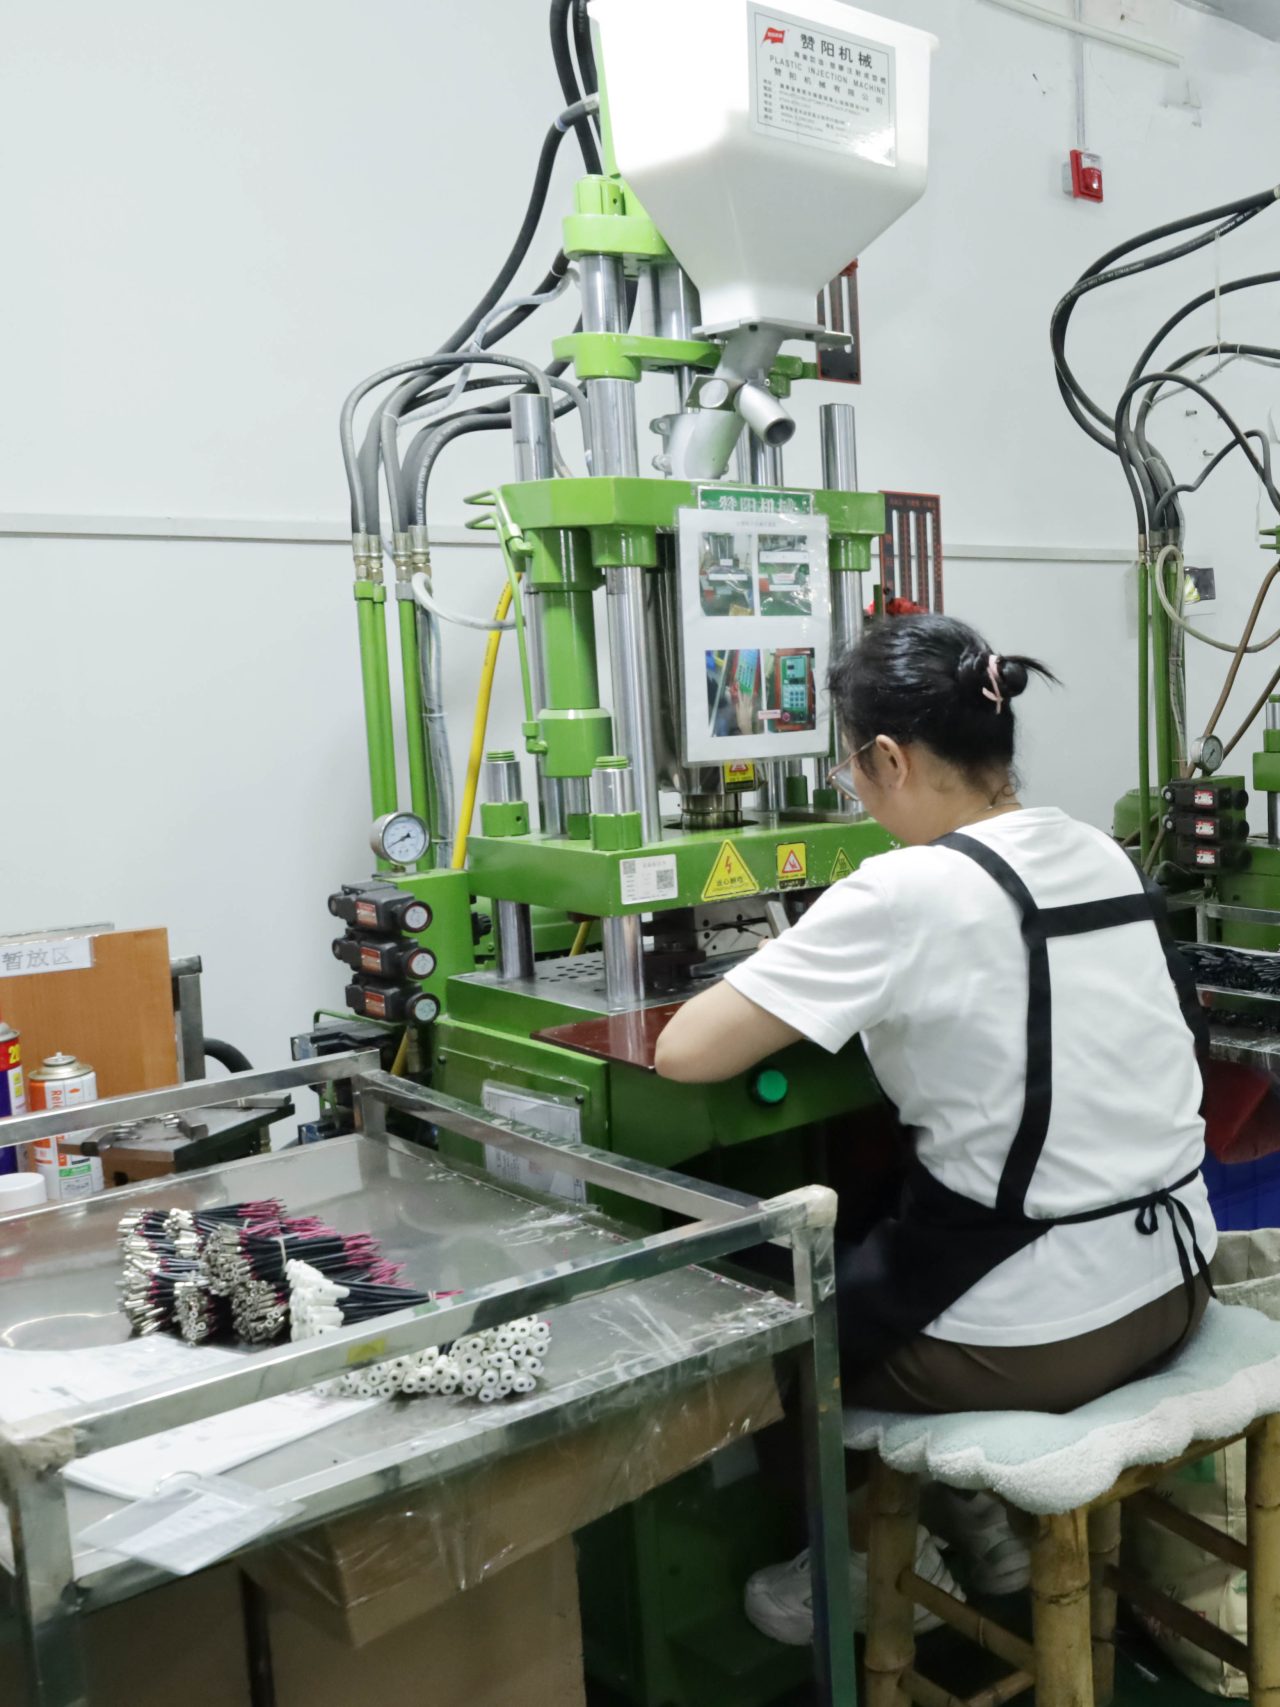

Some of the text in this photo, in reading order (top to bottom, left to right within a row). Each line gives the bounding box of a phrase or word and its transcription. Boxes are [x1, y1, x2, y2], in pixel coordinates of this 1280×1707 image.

[800, 33, 873, 69] 赞阳机械
[769, 54, 802, 71] PLASTIC
[808, 66, 848, 84] INJECTION
[853, 78, 886, 95] MACHINE
[1, 948, 72, 971] 暂放区
